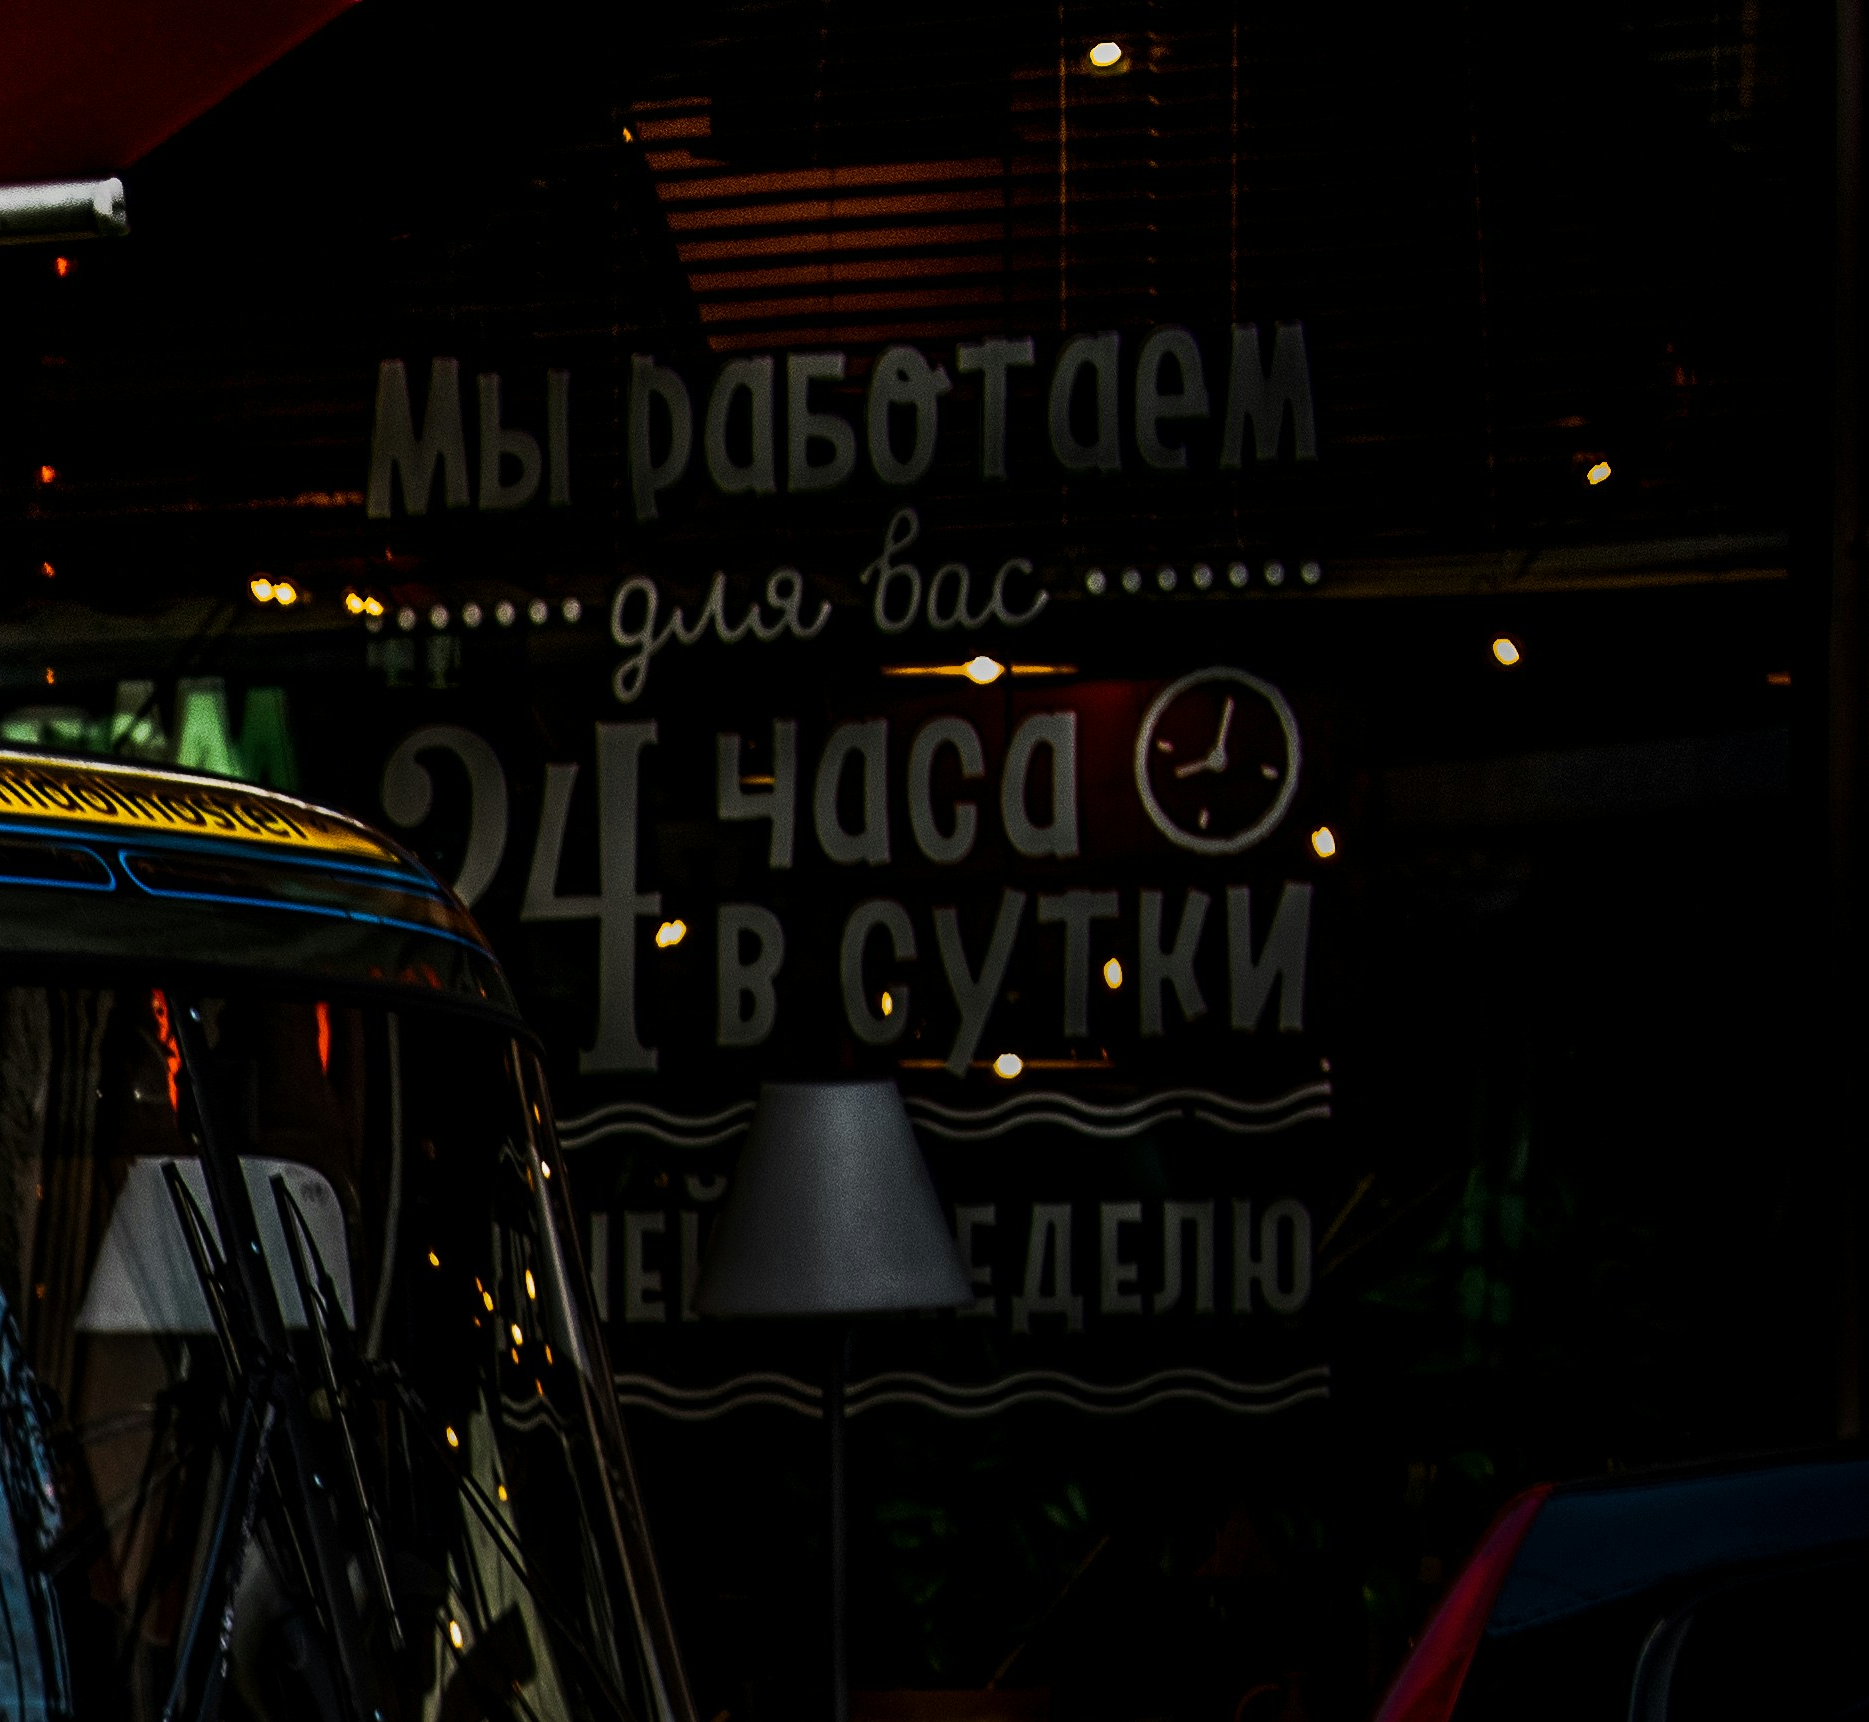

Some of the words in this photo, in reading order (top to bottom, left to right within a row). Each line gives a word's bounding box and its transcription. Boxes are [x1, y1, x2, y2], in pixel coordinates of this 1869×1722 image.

[366, 355, 572, 519] Мы
[627, 320, 1319, 523] работаем
[609, 570, 833, 703] для
[860, 506, 1051, 634] вас
[715, 709, 1082, 870] часа
[380, 717, 663, 1077] 24
[839, 881, 1317, 1079] сутки
[953, 1193, 1315, 1337] ЕДЕЛЮ
